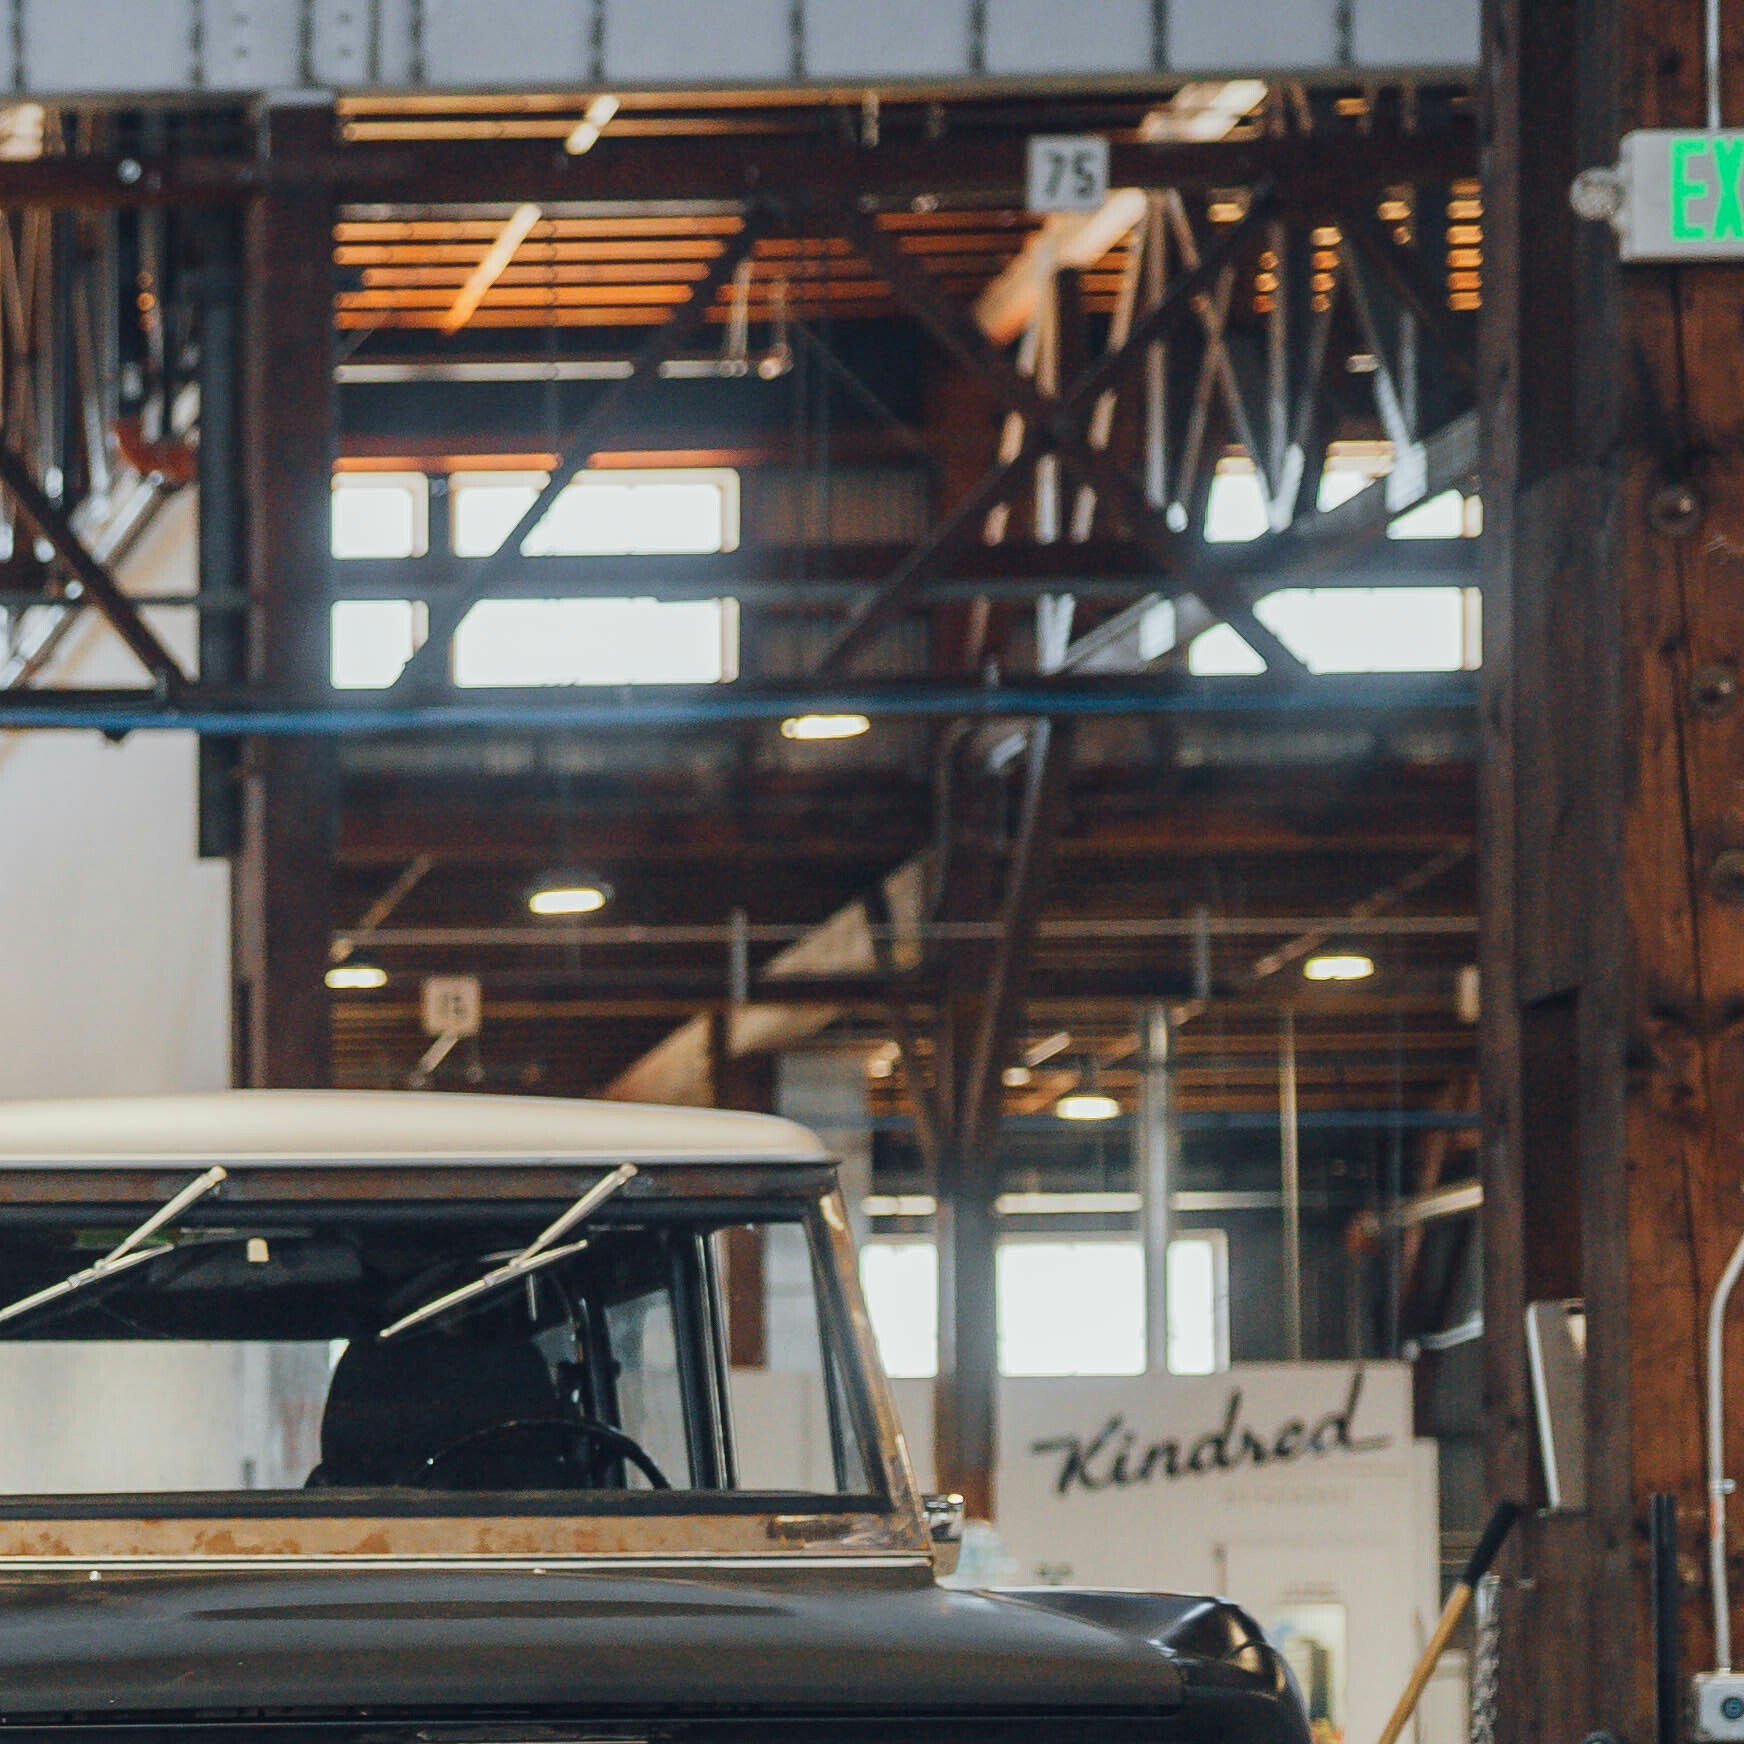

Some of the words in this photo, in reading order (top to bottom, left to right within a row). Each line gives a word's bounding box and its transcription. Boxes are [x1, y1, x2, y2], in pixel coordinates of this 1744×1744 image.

[1044, 149, 1097, 200] 75
[1670, 136, 1744, 242] EX
[1030, 1359, 1393, 1497] Kindred
